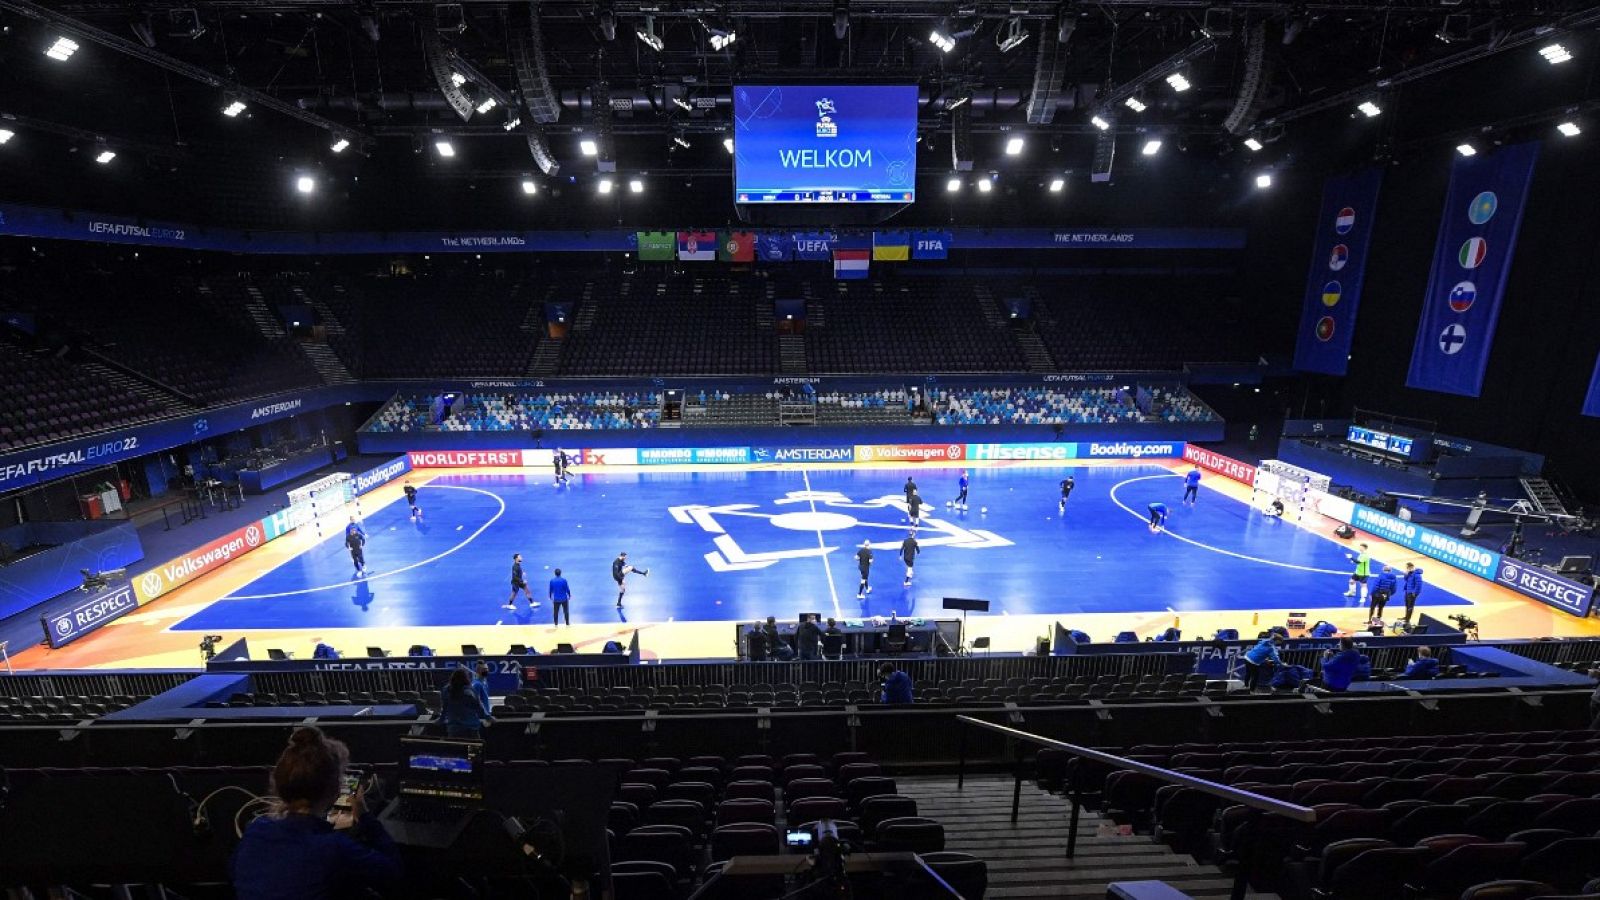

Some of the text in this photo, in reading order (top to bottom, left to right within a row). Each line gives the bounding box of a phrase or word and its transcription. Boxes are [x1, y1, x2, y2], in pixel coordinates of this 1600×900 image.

[779, 149, 873, 169] WELKOM
[89, 221, 115, 235] UEFA
[115, 224, 151, 237] FUTSAL
[441, 237, 460, 247] THE
[797, 240, 829, 252] UEFA
[918, 240, 943, 250] FIFA
[1054, 234, 1135, 243] THE NETHERLANDS
[251, 399, 302, 420] AMSTERDAM
[566, 448, 606, 466] edEx
[650, 450, 691, 458] MONDO
[704, 449, 747, 457] MONDO
[775, 449, 851, 459] AMSTERDAM
[876, 447, 945, 458] Volkswagen
[975, 444, 1067, 460] Hisense
[1089, 443, 1173, 456] Booking.com
[0, 463, 26, 481] EFA
[27, 450, 86, 475] FUTSAL
[411, 451, 519, 465] WORLDFIRST
[1185, 446, 1255, 482] WORLDFIRST
[357, 461, 405, 490] Booking.com
[1366, 509, 1416, 539] MONDO
[1431, 535, 1492, 567] MONDO
[164, 535, 244, 584] Volkswagen
[1519, 572, 1586, 607] RESPECT
[75, 588, 132, 627] RESPECT
